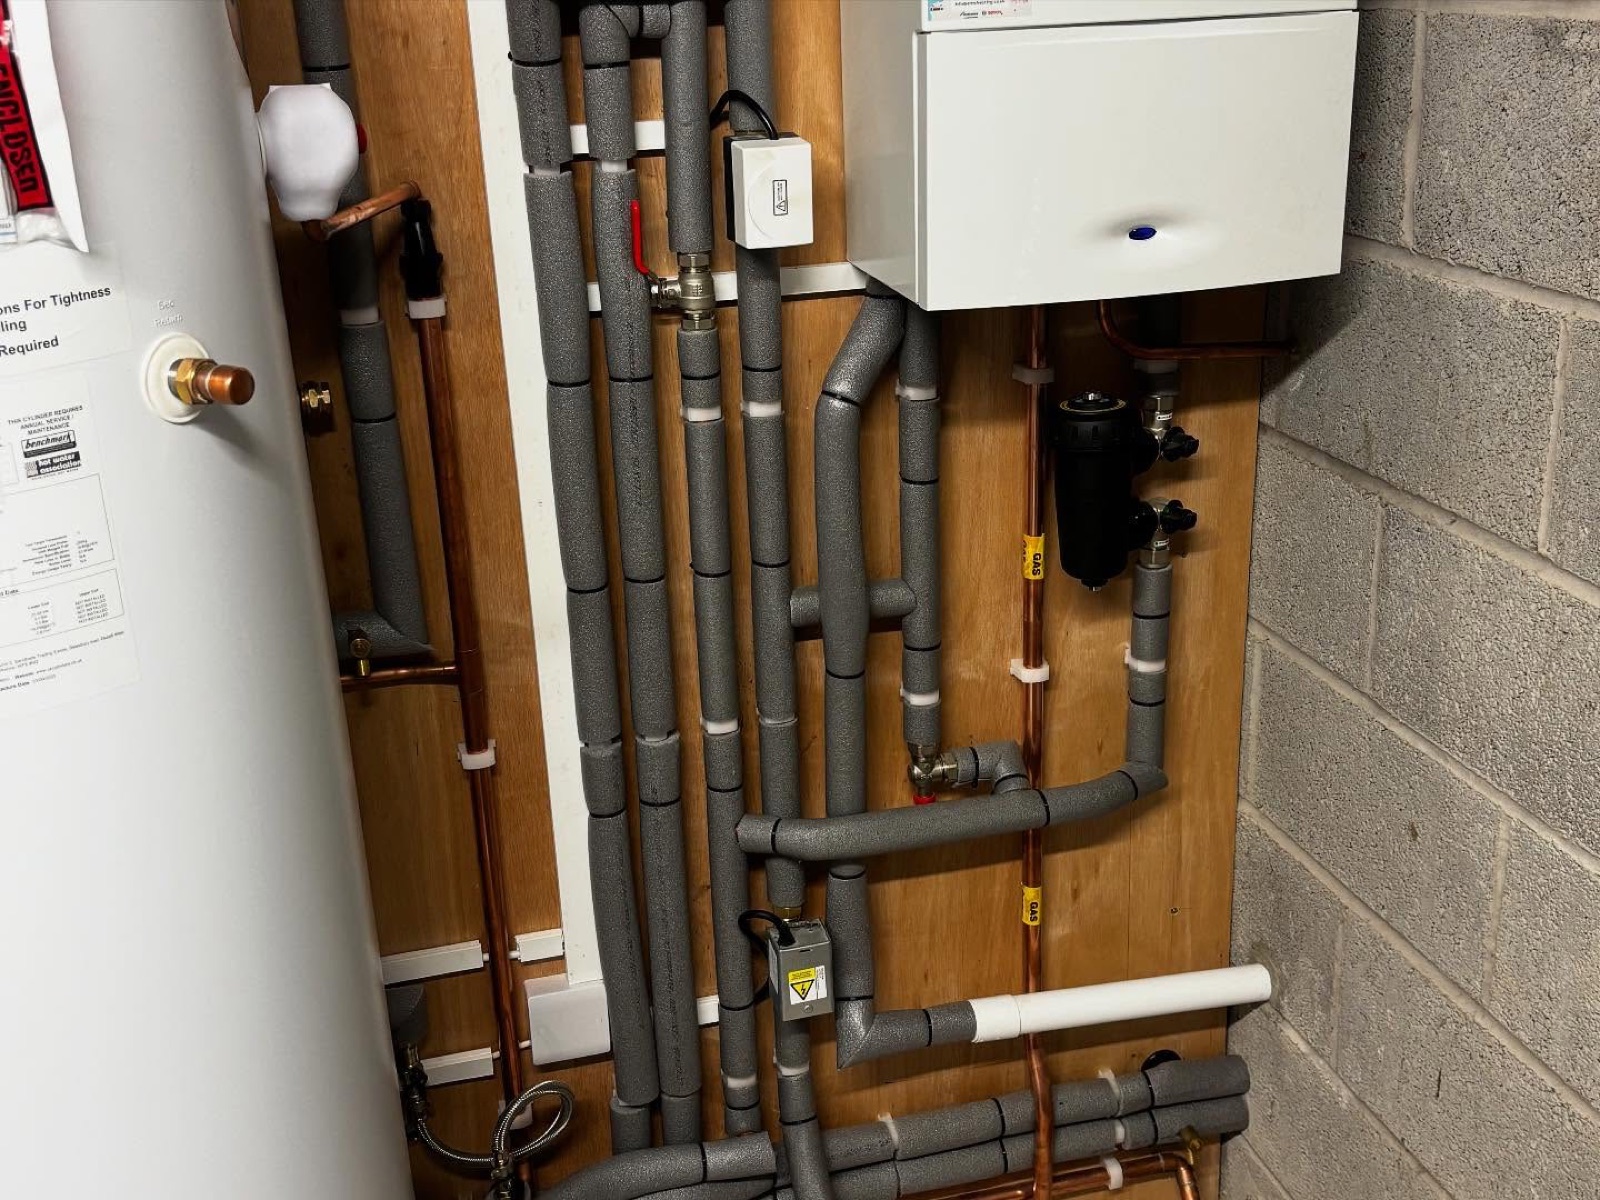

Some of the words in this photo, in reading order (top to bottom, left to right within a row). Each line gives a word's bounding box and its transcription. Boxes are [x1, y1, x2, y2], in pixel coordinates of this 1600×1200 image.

[24, 299, 47, 311] For
[50, 286, 111, 307] Tightness
[0, 335, 59, 357] Required
[25, 431, 72, 449] benchmark
[1032, 552, 1041, 576] GAS
[1030, 901, 1039, 922] GAS
